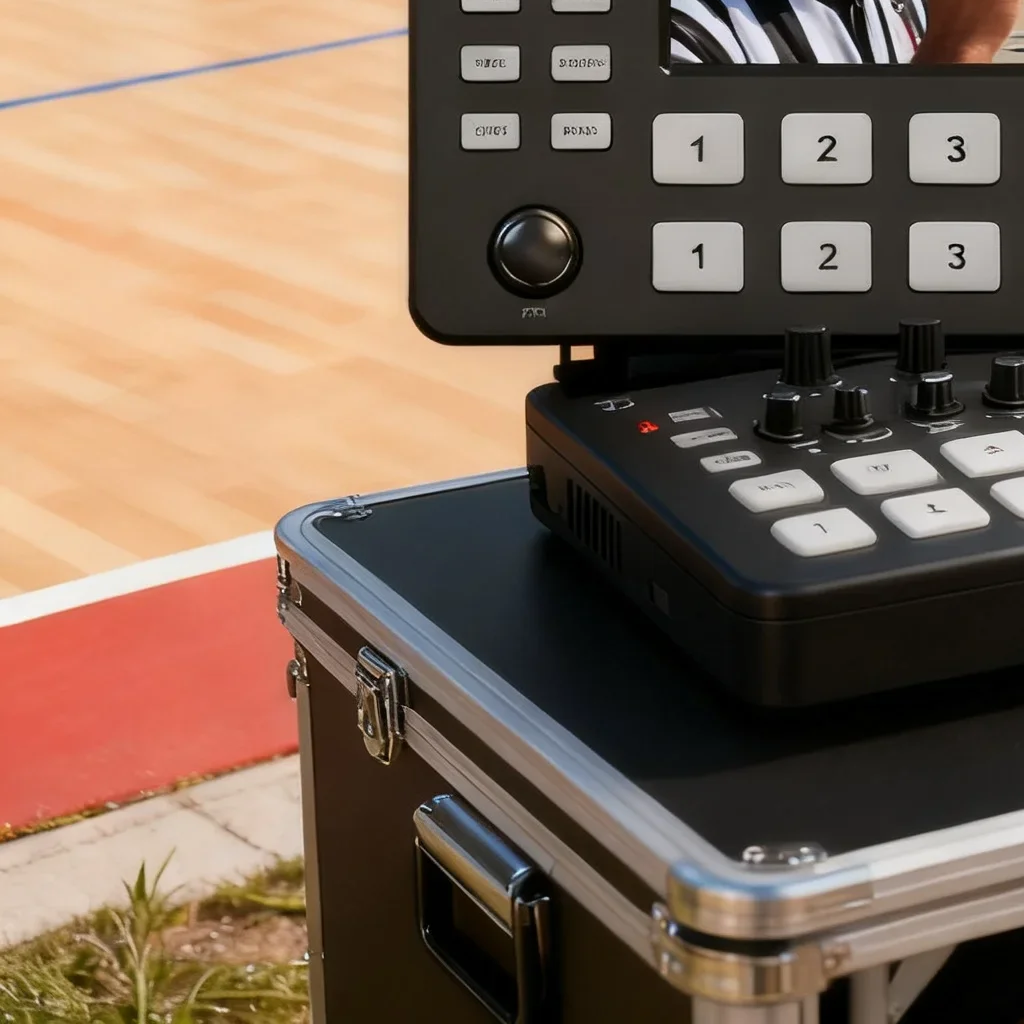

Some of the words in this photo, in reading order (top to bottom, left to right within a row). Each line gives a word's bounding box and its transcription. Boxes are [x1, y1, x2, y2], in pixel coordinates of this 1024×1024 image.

[690, 135, 704, 163] 1
[816, 135, 838, 163] 2
[946, 135, 967, 163] 3
[690, 242, 704, 270] 1
[818, 242, 839, 271] 2
[947, 243, 967, 271] 3
